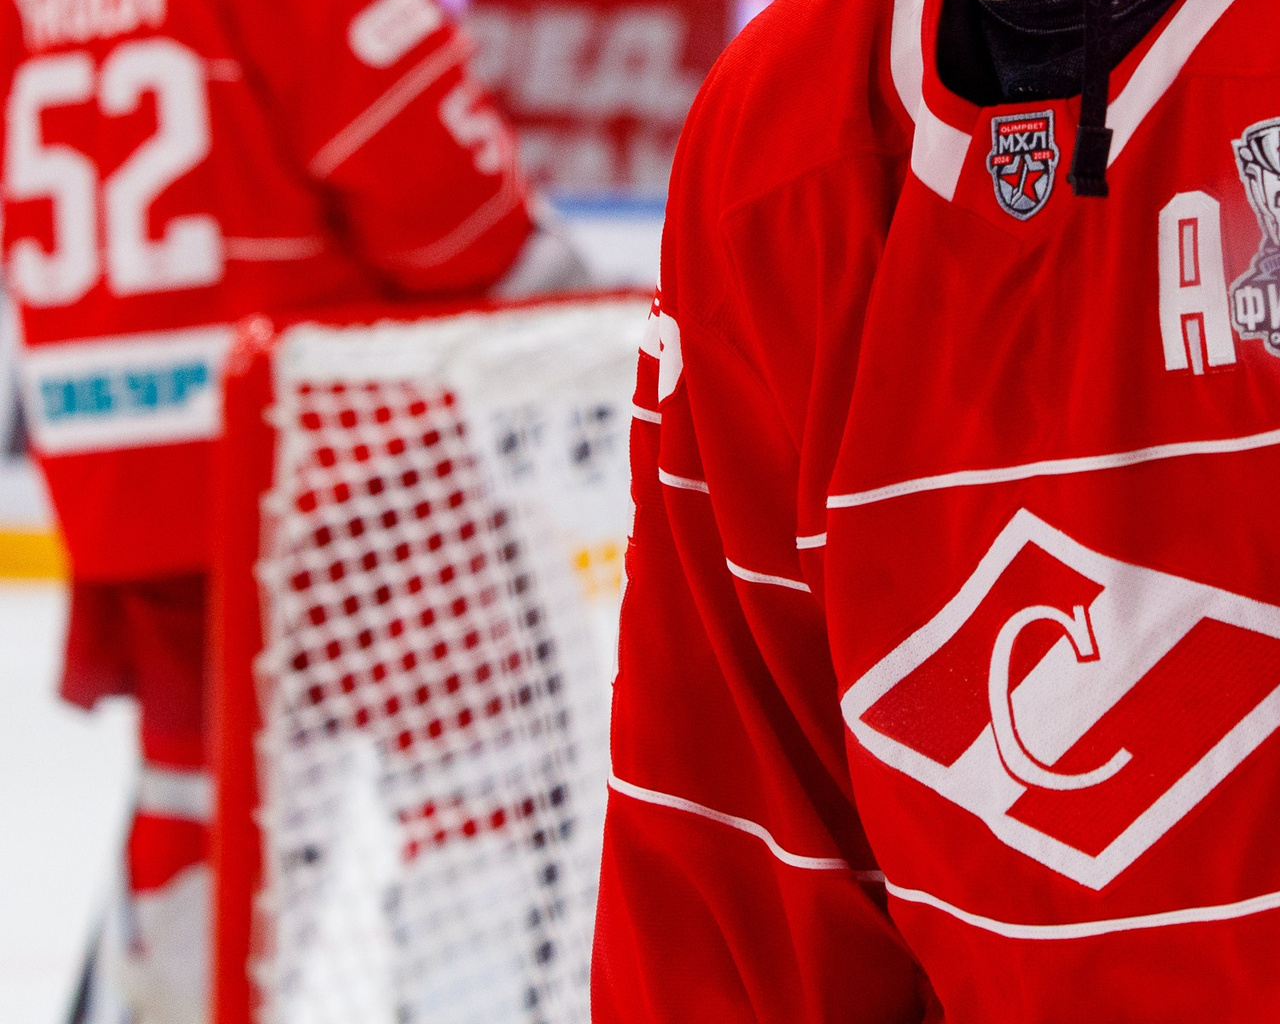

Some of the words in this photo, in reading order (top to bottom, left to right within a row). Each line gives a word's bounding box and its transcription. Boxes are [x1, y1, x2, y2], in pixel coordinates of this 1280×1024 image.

[1000, 122, 1044, 133] OLIMPBET
[999, 131, 1047, 154] МХЛ
[4, 36, 222, 308] 52
